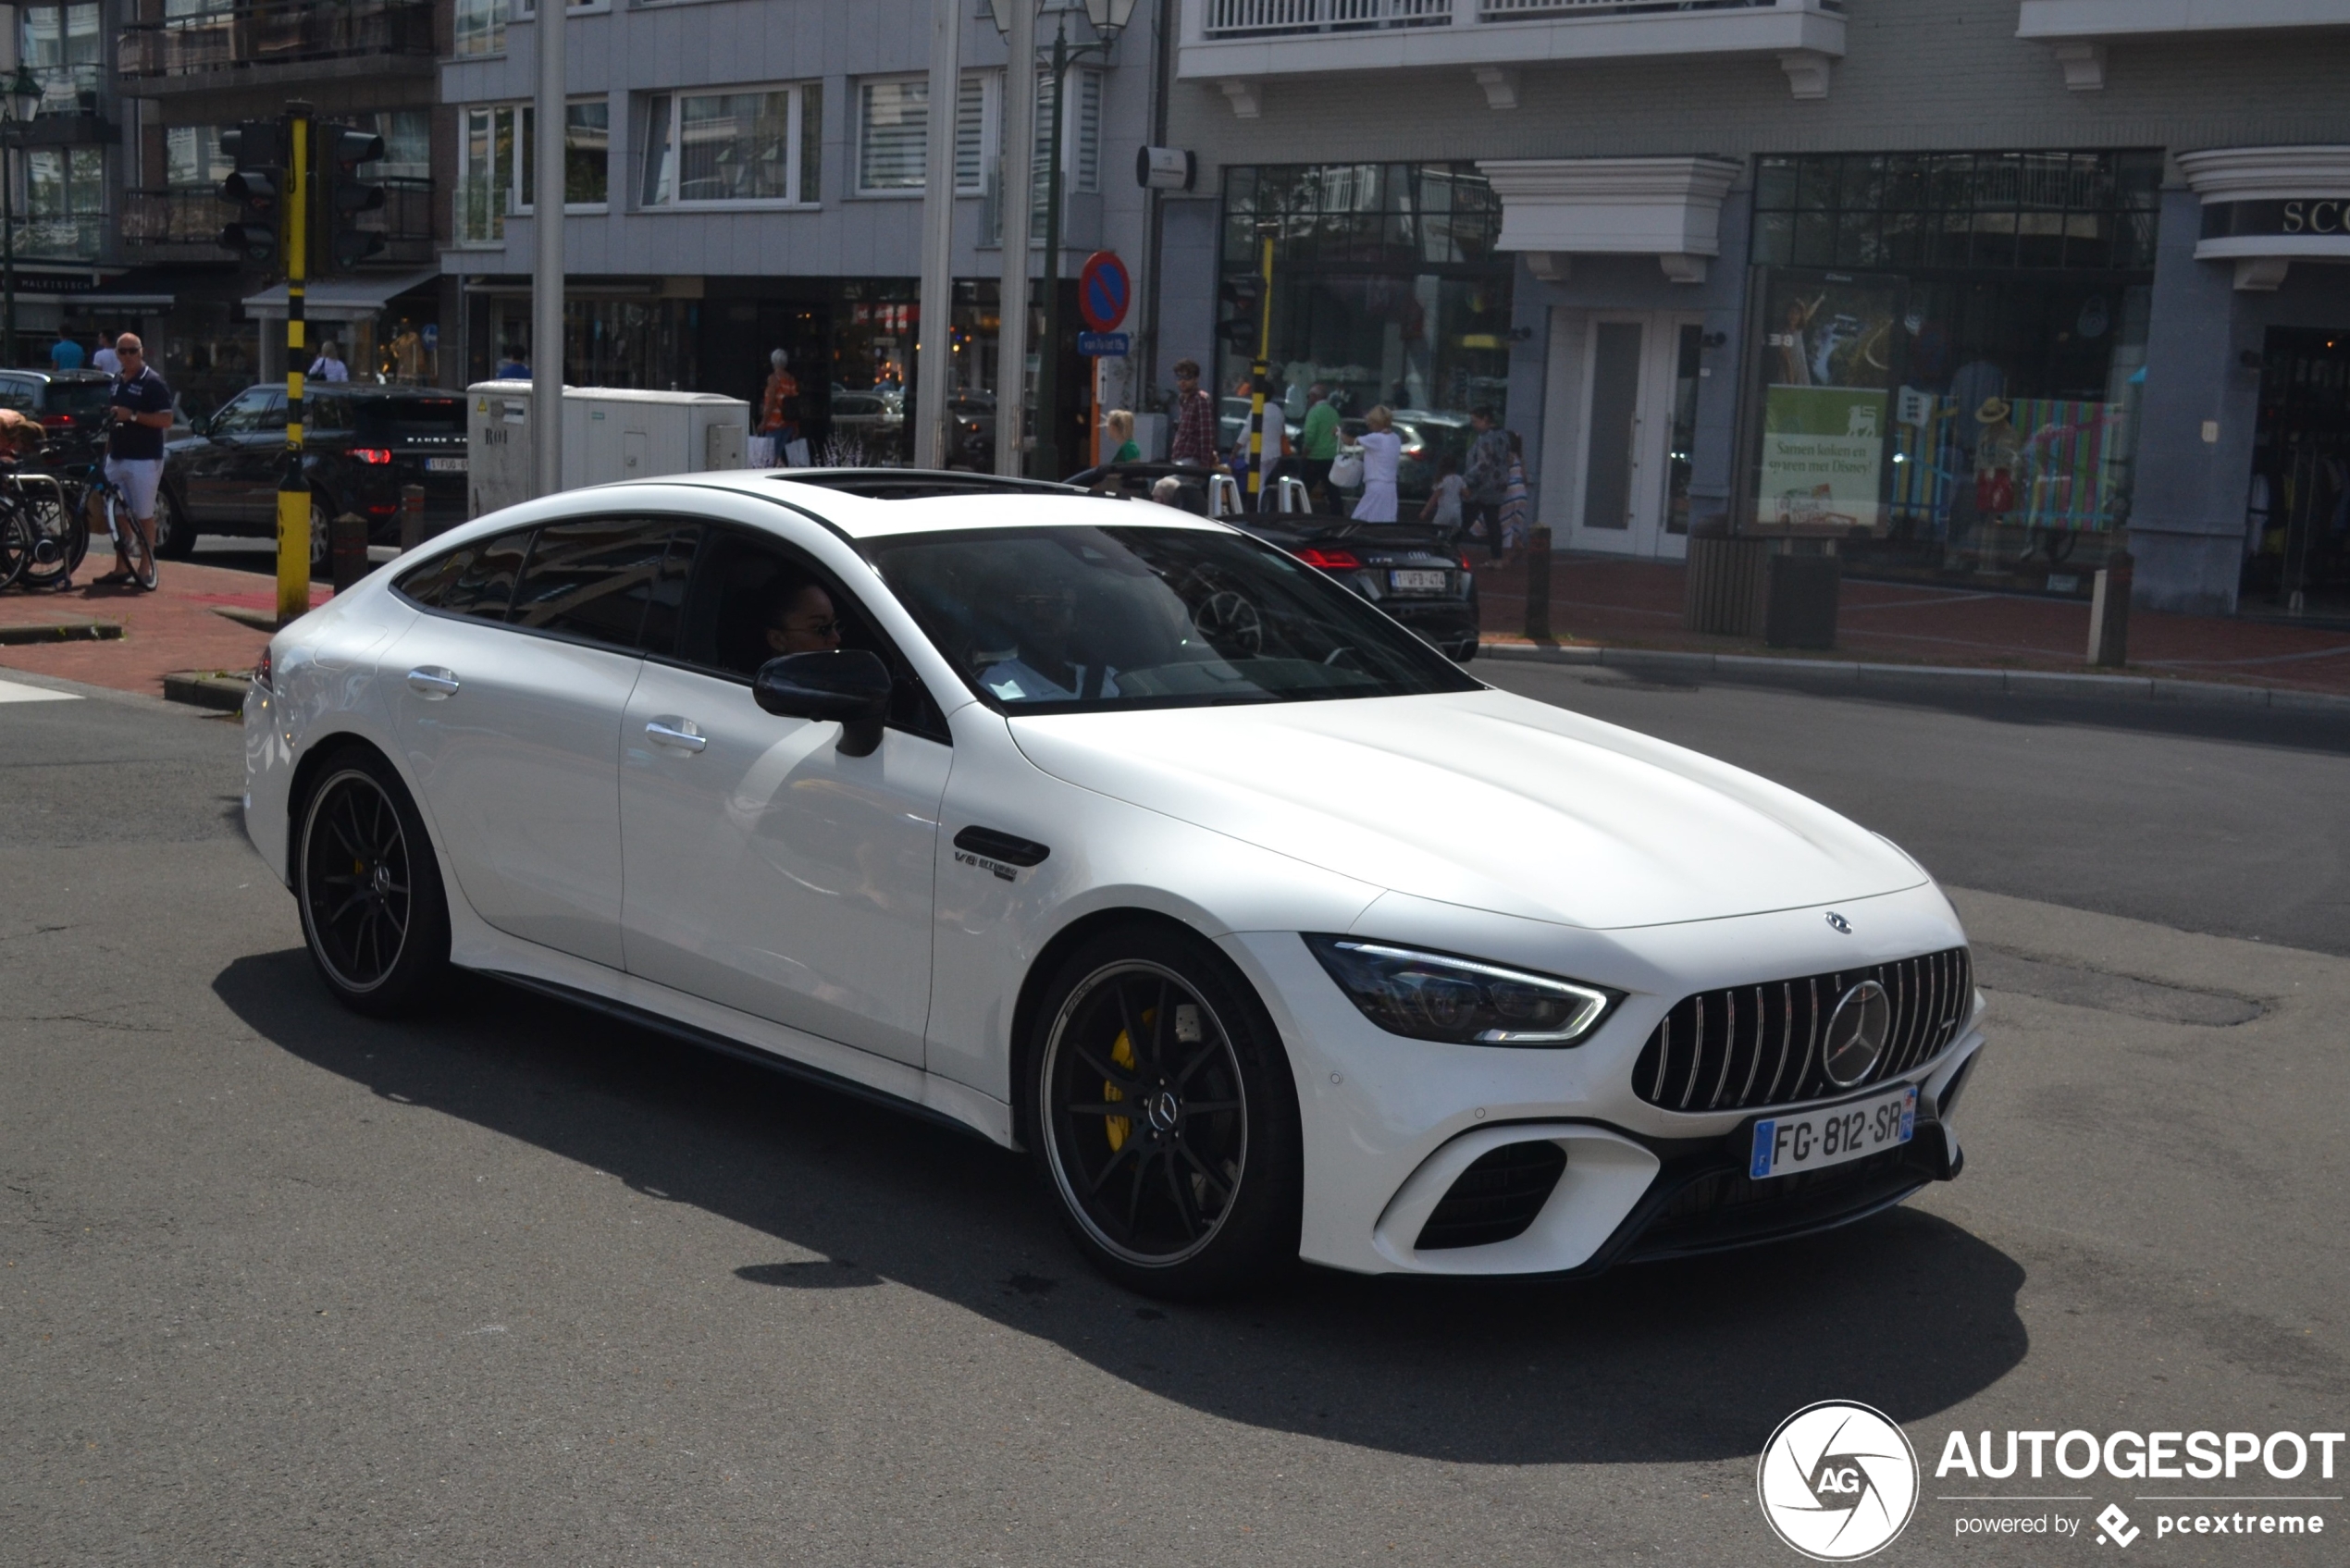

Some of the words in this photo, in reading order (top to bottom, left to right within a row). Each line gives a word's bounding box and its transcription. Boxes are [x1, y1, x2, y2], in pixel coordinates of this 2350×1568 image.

[2282, 201, 2350, 233] SC
[1776, 441, 1815, 455] Samen
[1817, 443, 1851, 458] koken
[1852, 447, 1867, 457] en
[1768, 461, 1808, 474] sparen
[1809, 461, 1829, 473] met
[955, 850, 977, 866] V8
[1773, 1100, 1902, 1166] FG-812-SR
